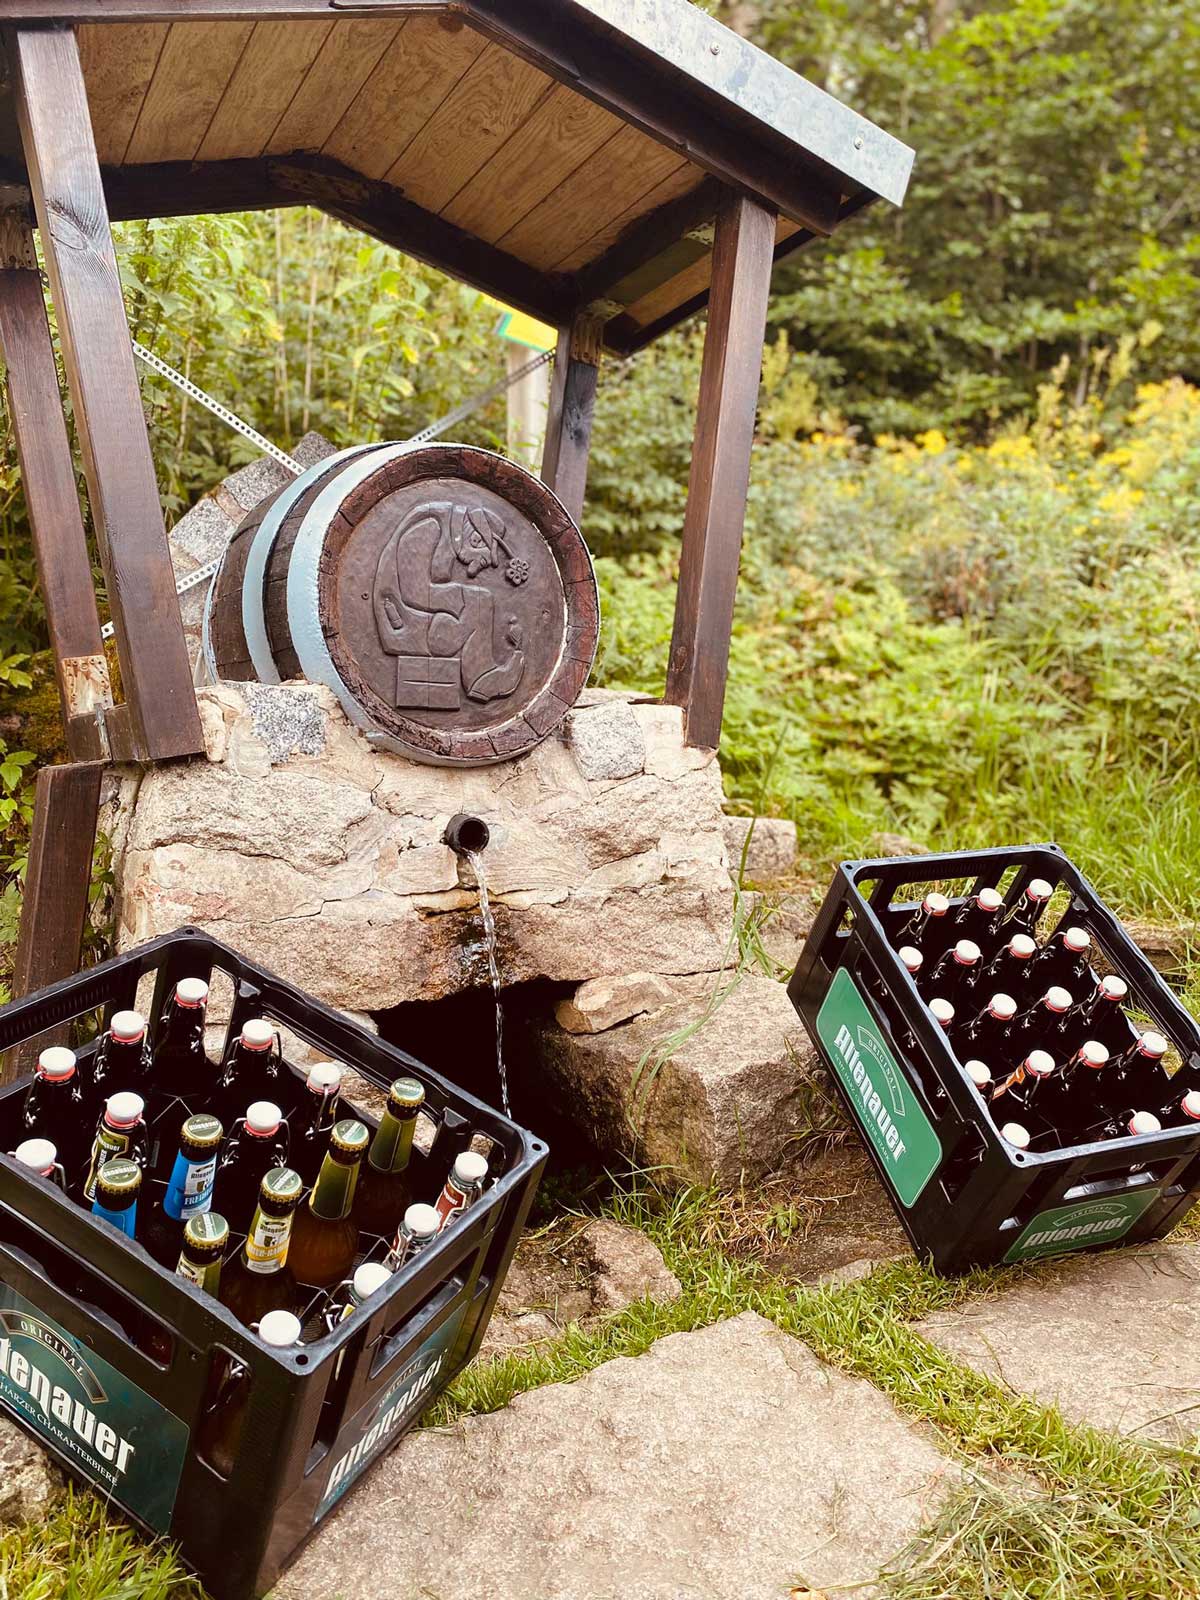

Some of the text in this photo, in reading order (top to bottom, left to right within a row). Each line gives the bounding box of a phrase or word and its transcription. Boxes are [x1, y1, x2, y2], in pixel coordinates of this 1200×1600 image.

[834, 1024, 906, 1162] Altenauer
[868, 1039, 896, 1091] ORIGINAL
[1020, 1214, 1132, 1250] Altenauer
[20, 1320, 84, 1376] ORIGINAL
[37, 1411, 118, 1487] CHARAKTERBIERE
[323, 1348, 448, 1500] Altenauer
